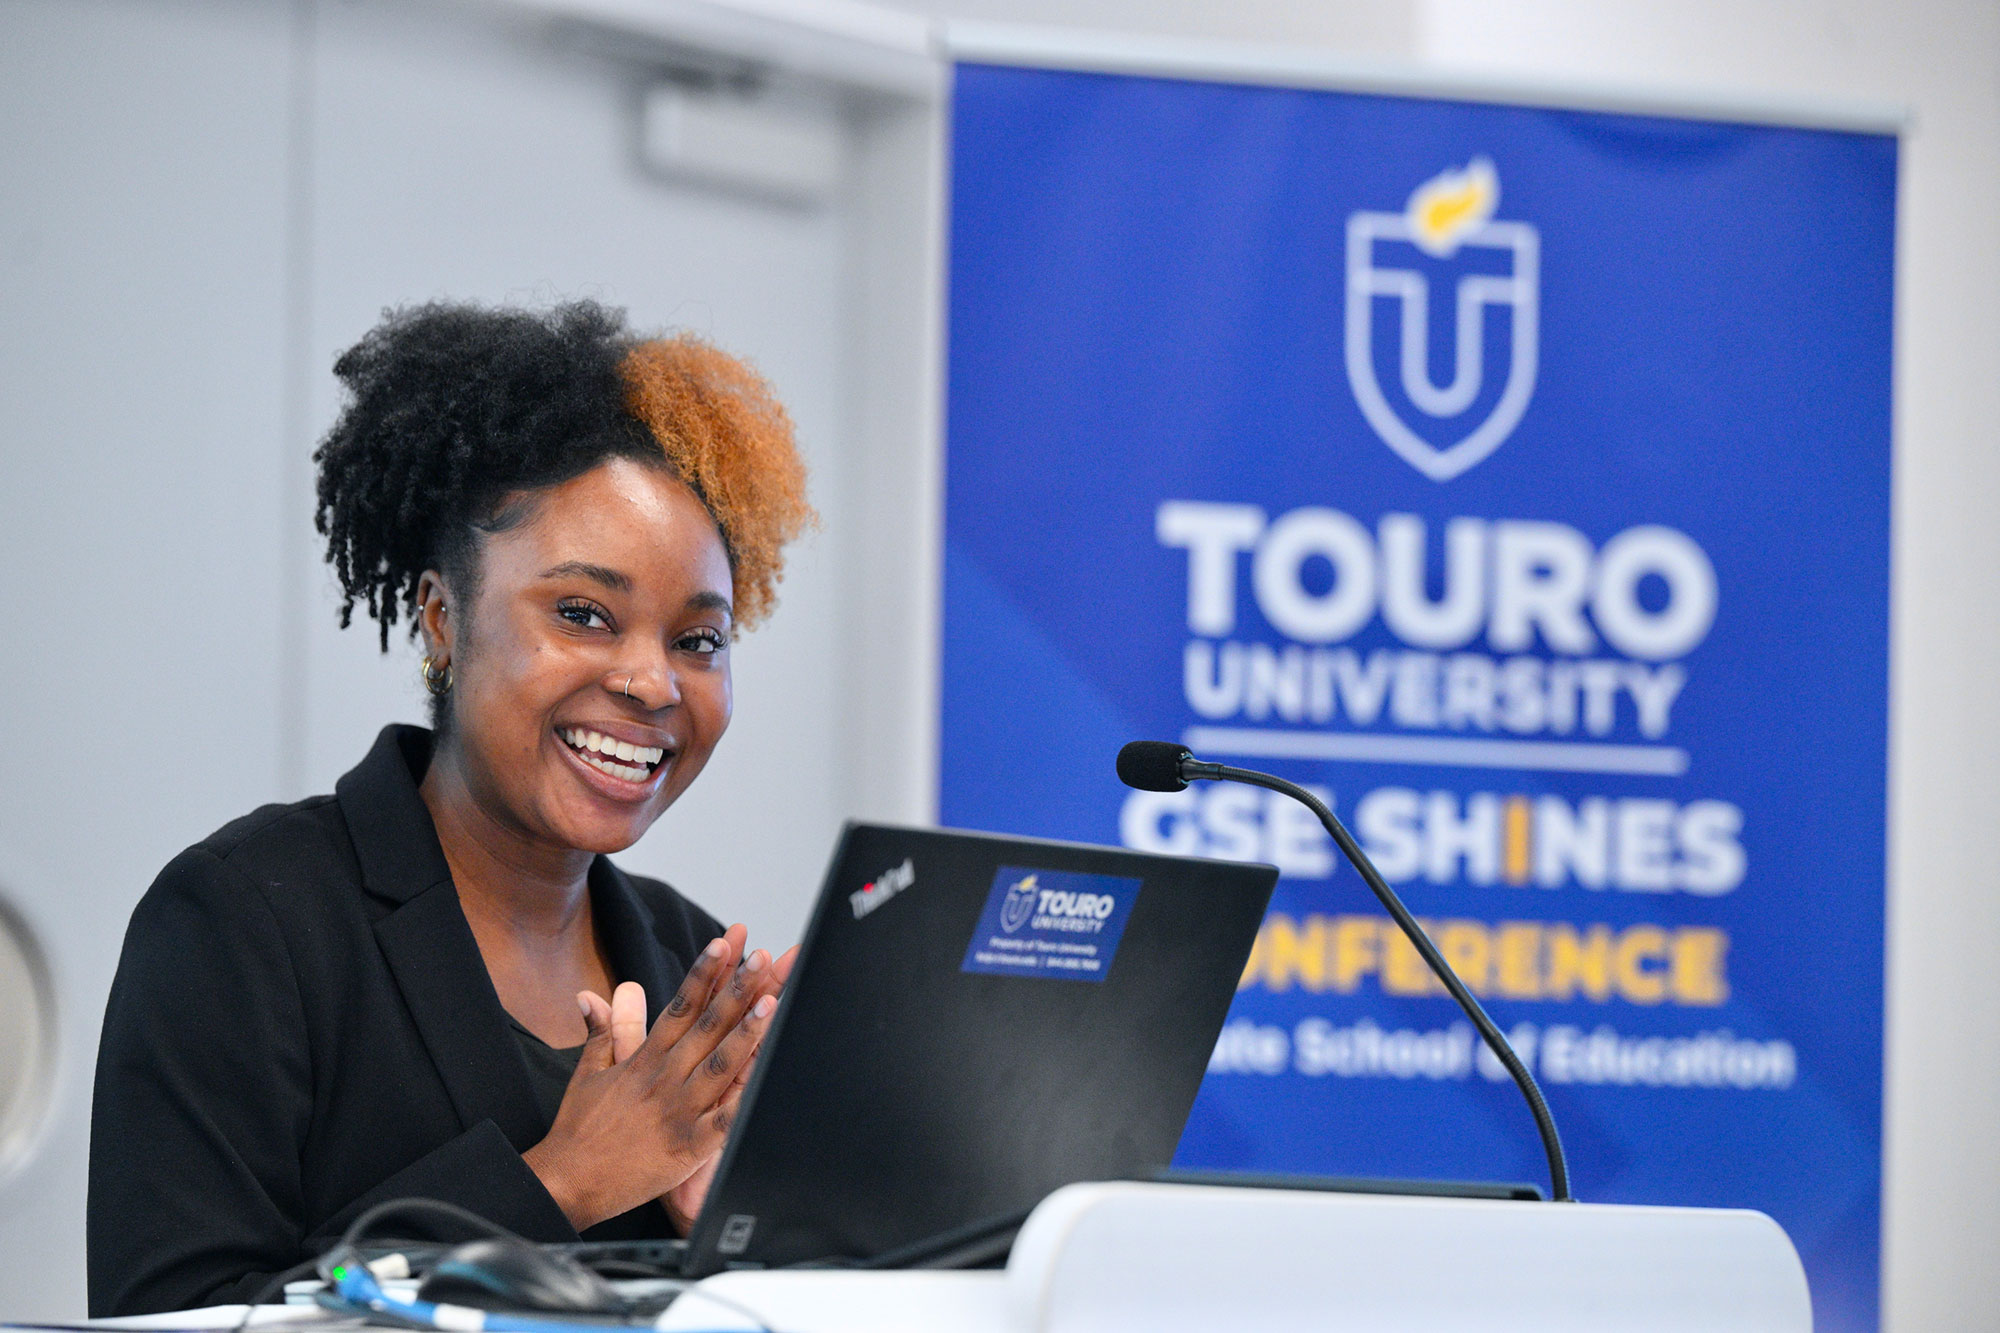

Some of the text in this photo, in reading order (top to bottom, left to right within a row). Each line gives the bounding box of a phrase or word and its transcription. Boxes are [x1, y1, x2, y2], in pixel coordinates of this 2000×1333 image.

[1158, 502, 1718, 660] TOURO
[1184, 641, 1685, 738] UNIVERSITY
[1120, 783, 1746, 894] GSE SHINES
[1031, 915, 1105, 933] UNIVERSITY
[1038, 890, 1114, 919] TOURO
[1238, 912, 1729, 1006] NFERENCE
[1295, 1017, 1472, 1079] School
[1542, 1025, 1795, 1088] Education
